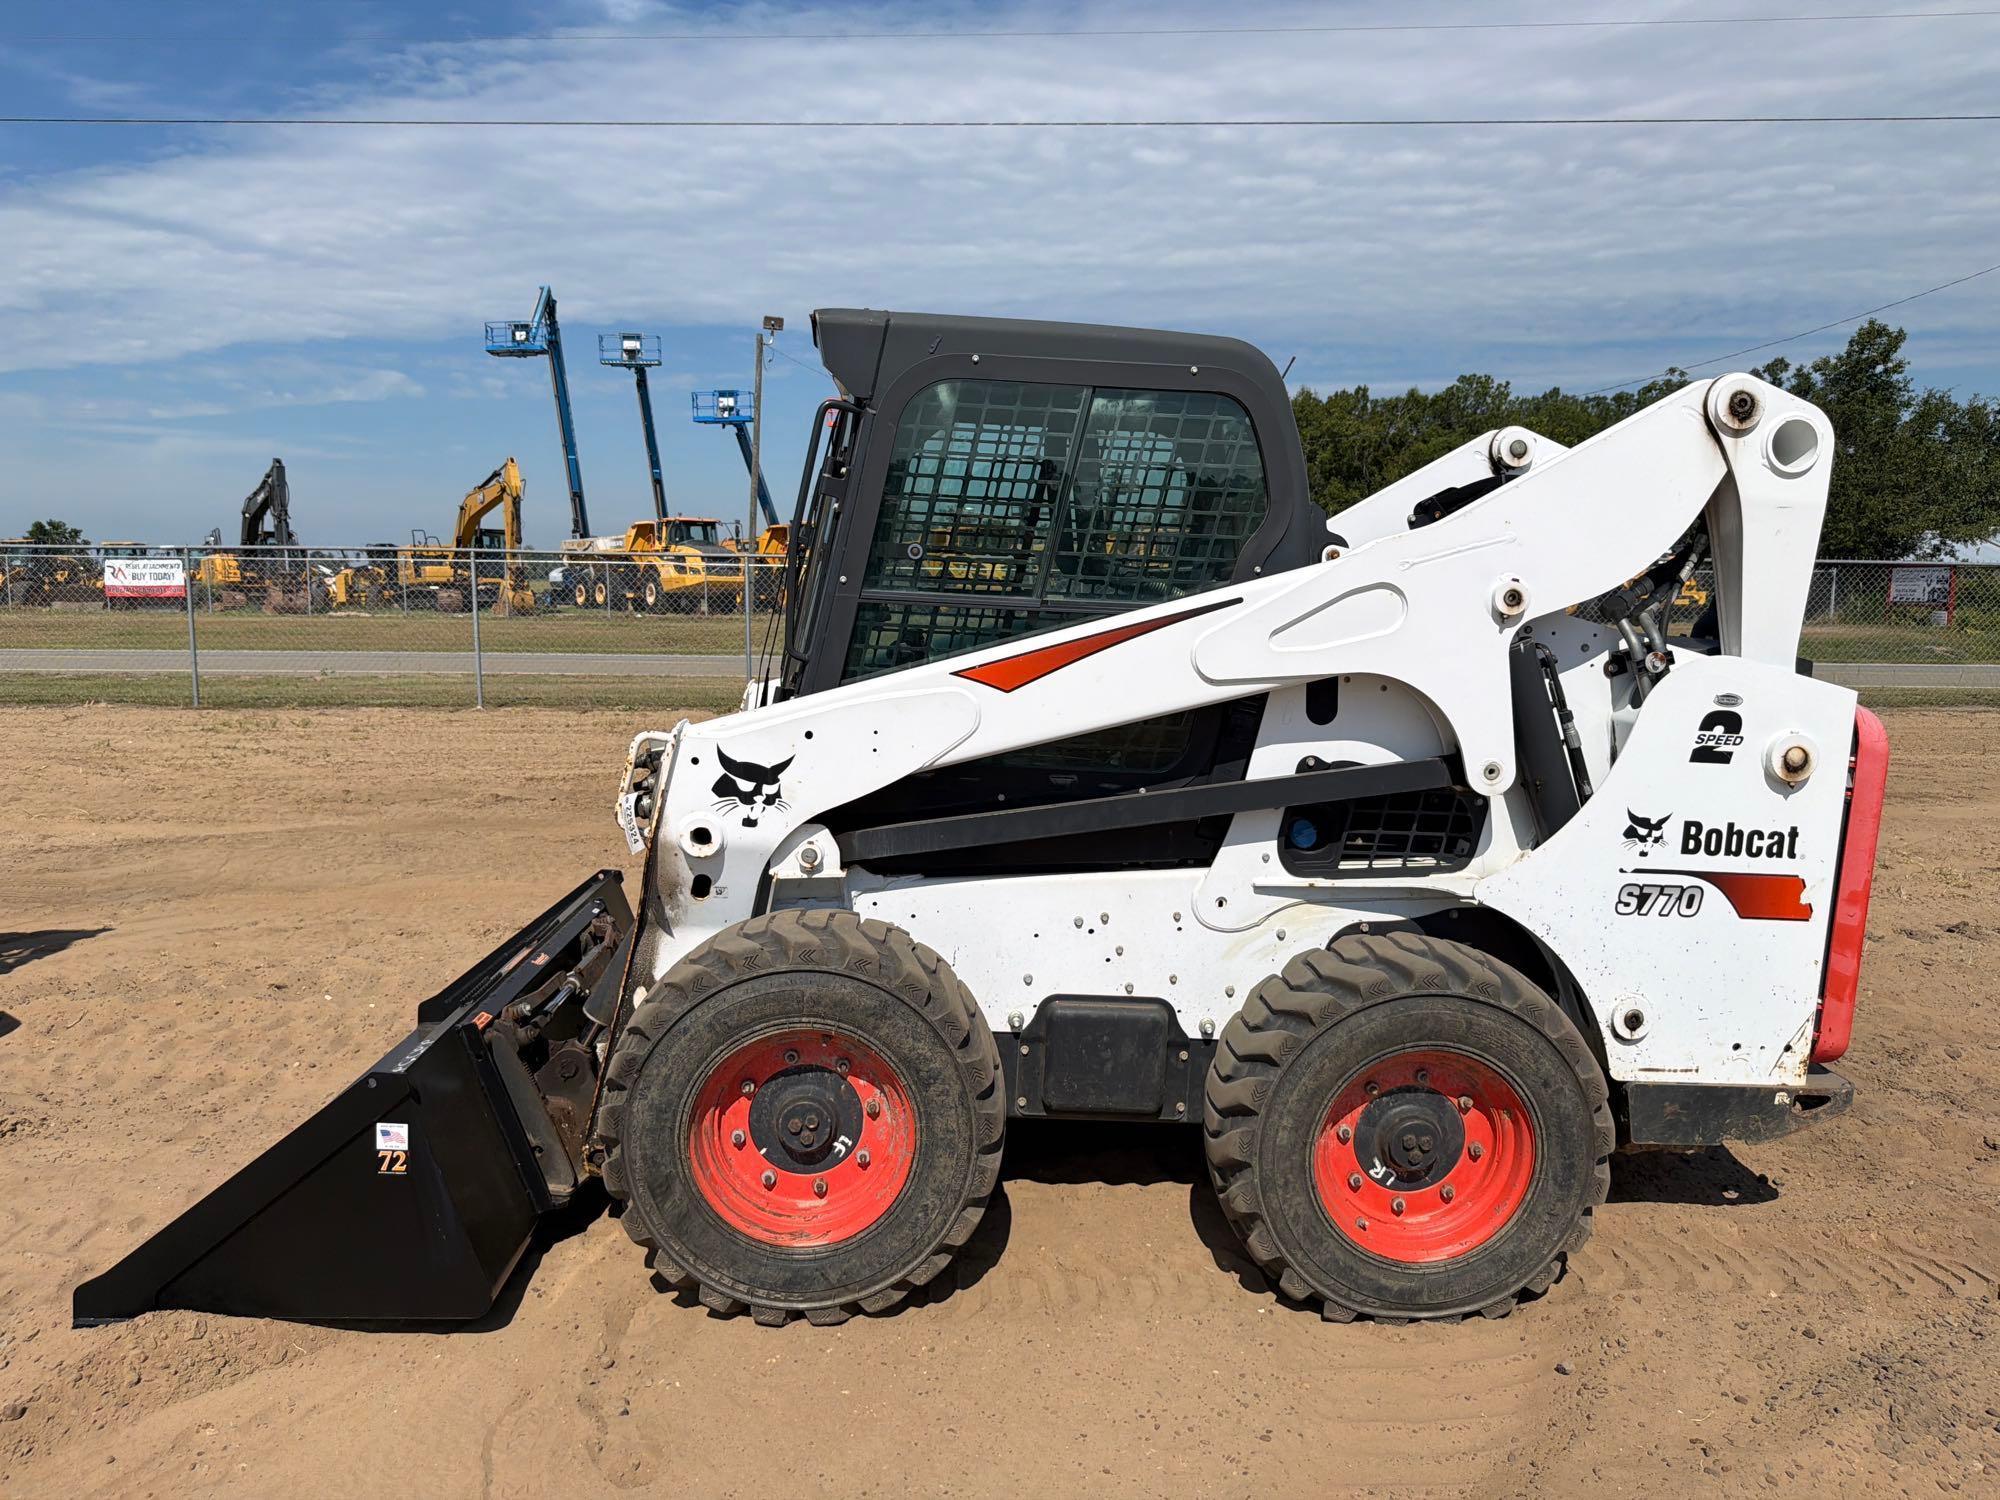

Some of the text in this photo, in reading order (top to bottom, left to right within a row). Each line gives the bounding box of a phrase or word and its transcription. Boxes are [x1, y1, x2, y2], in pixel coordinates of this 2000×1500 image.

[1689, 709, 1743, 764] 2
[1695, 733, 1744, 746] SPEED
[1680, 820, 1799, 859] Bobcat
[1615, 883, 1704, 917] S770
[378, 1151, 407, 1171] 72
[1368, 1156, 1397, 1186] LR
